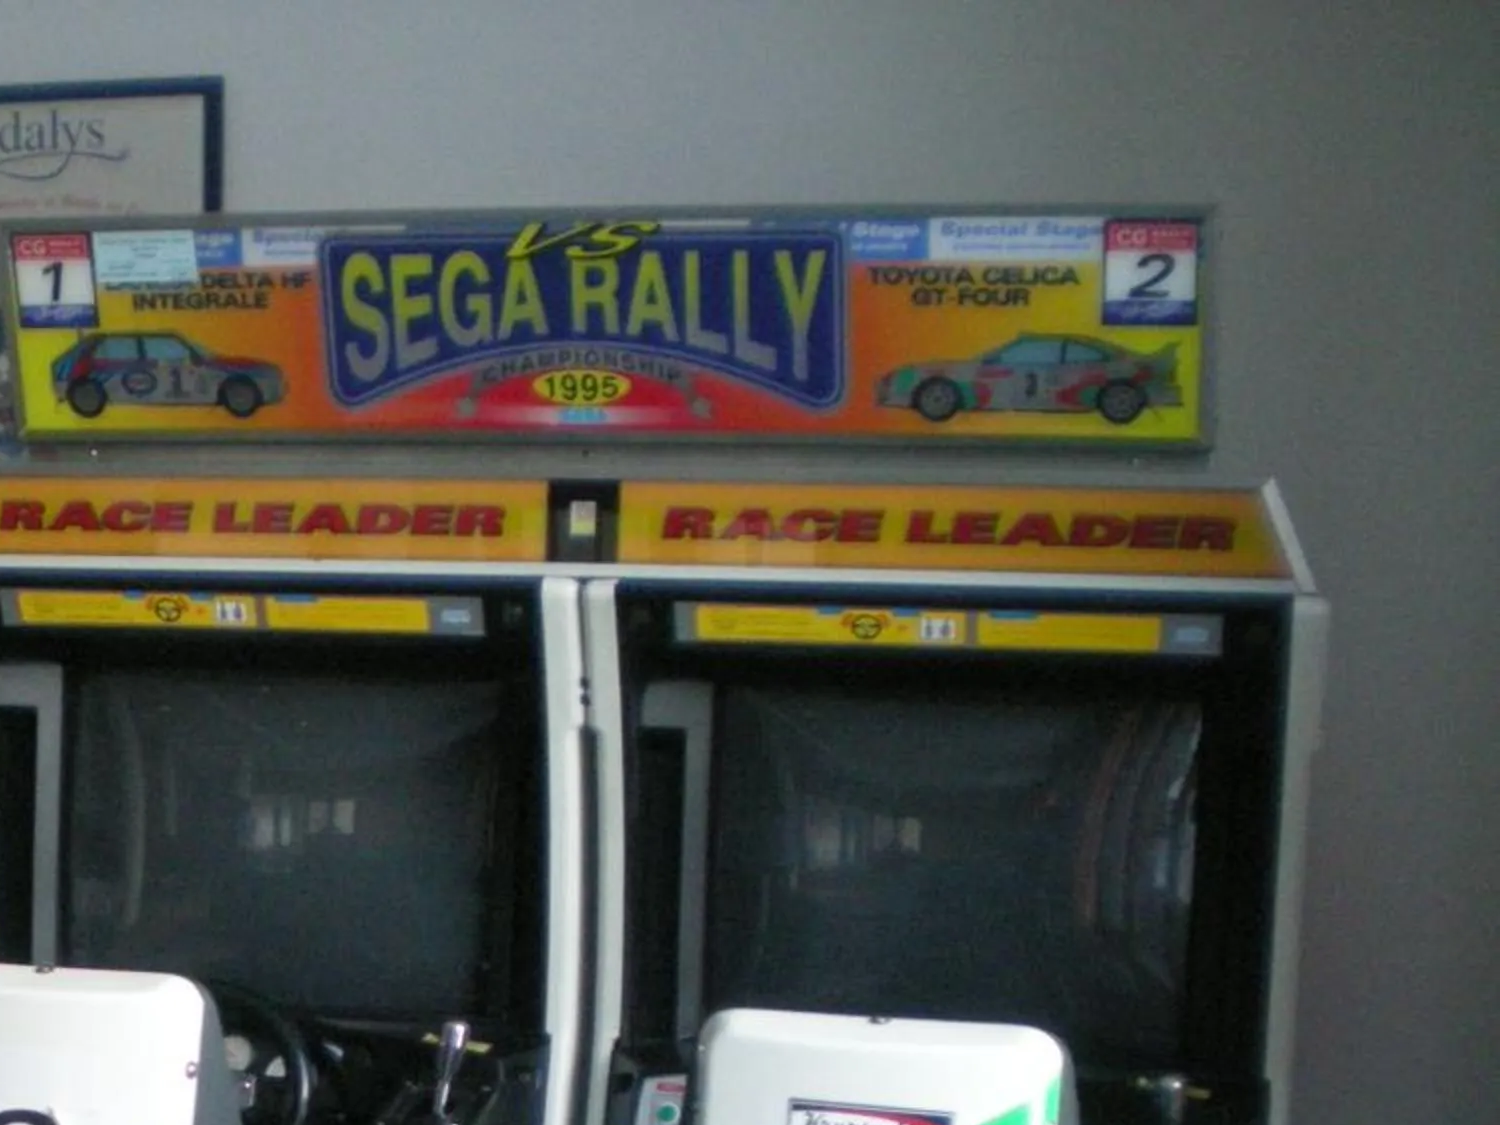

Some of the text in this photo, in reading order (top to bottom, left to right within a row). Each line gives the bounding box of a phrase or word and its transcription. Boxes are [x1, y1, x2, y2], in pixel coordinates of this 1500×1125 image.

[18, 239, 47, 256] CG
[1116, 227, 1147, 246] CG
[41, 261, 63, 302] 1
[200, 271, 274, 290] DELTA
[867, 266, 1080, 287] TOYOTA CELICA
[1128, 253, 1175, 298] 2
[131, 292, 270, 312] INTEGRALE
[341, 249, 827, 383] SEGA RALLY
[543, 374, 619, 400] 1995
[211, 500, 508, 538] LEADER
[660, 506, 1239, 552] RACE LEADER
